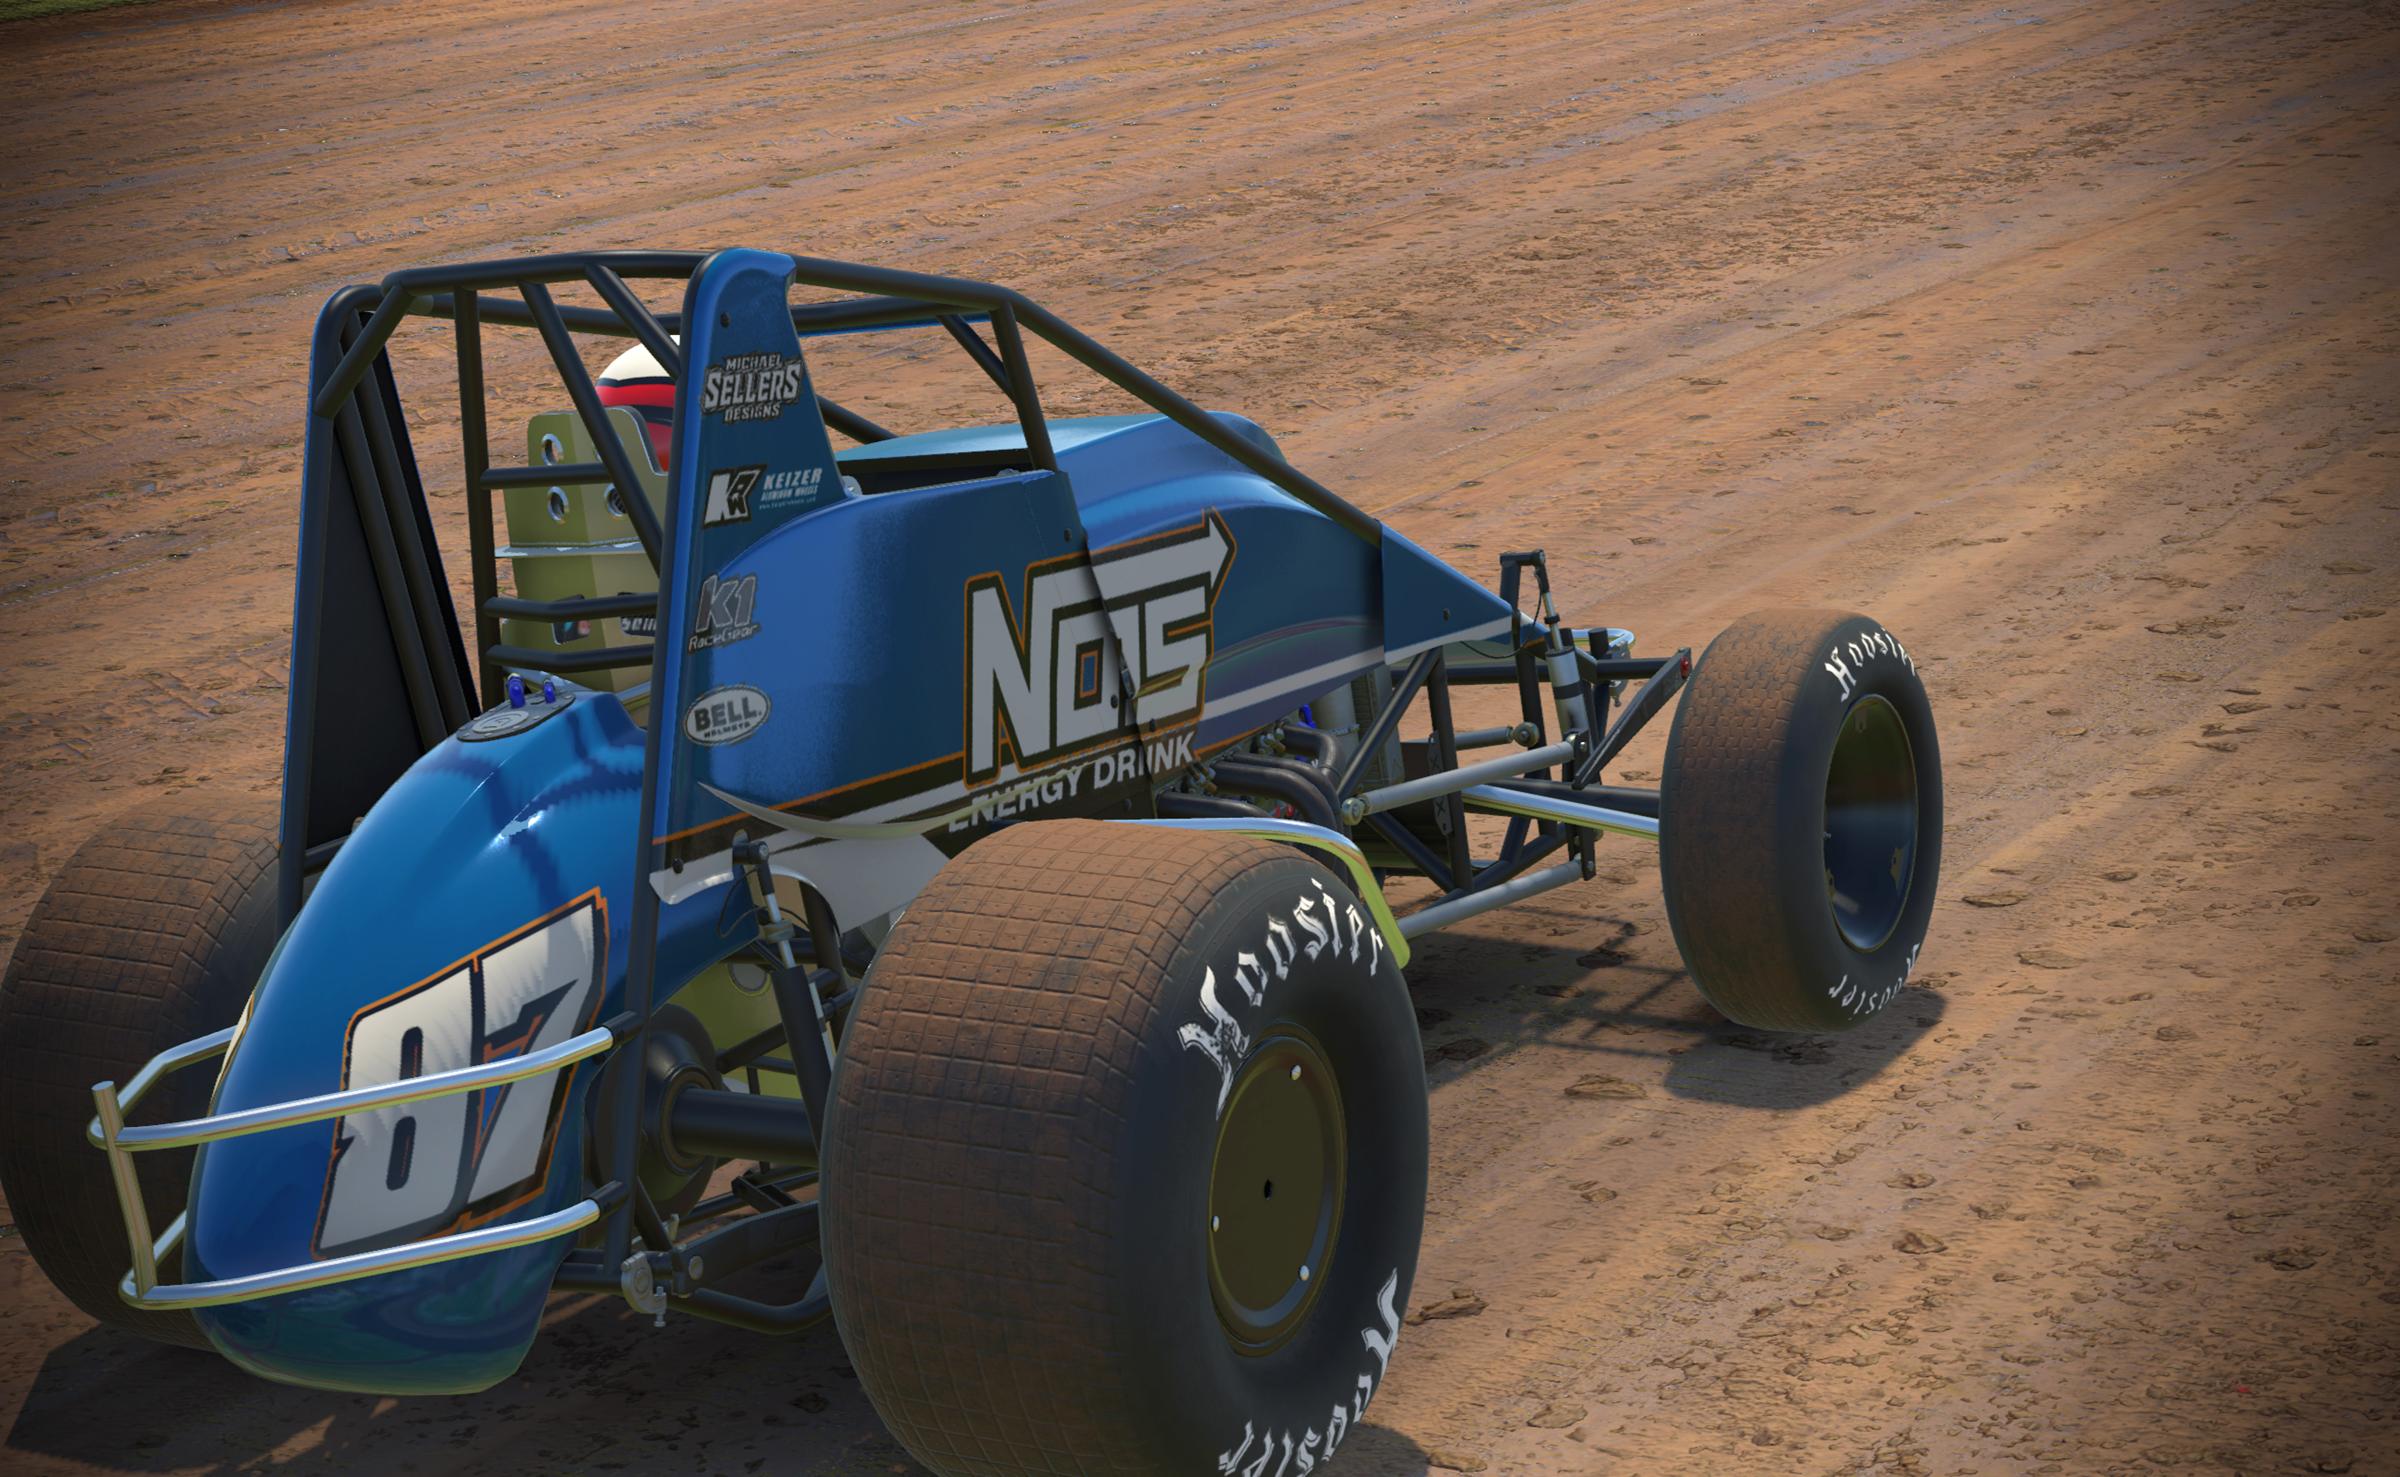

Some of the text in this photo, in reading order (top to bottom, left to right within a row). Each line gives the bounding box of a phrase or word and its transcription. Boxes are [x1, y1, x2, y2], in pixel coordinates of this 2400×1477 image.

[726, 354, 783, 371] MICHAEL
[704, 363, 801, 409] SELLERS
[724, 403, 781, 422] DESIGNS
[763, 467, 823, 490] KEIZER
[696, 574, 756, 633] K1
[971, 515, 1230, 776] NOS
[694, 696, 758, 732] BELL
[1093, 731, 1195, 790] DRINK
[318, 902, 597, 1252] 87
